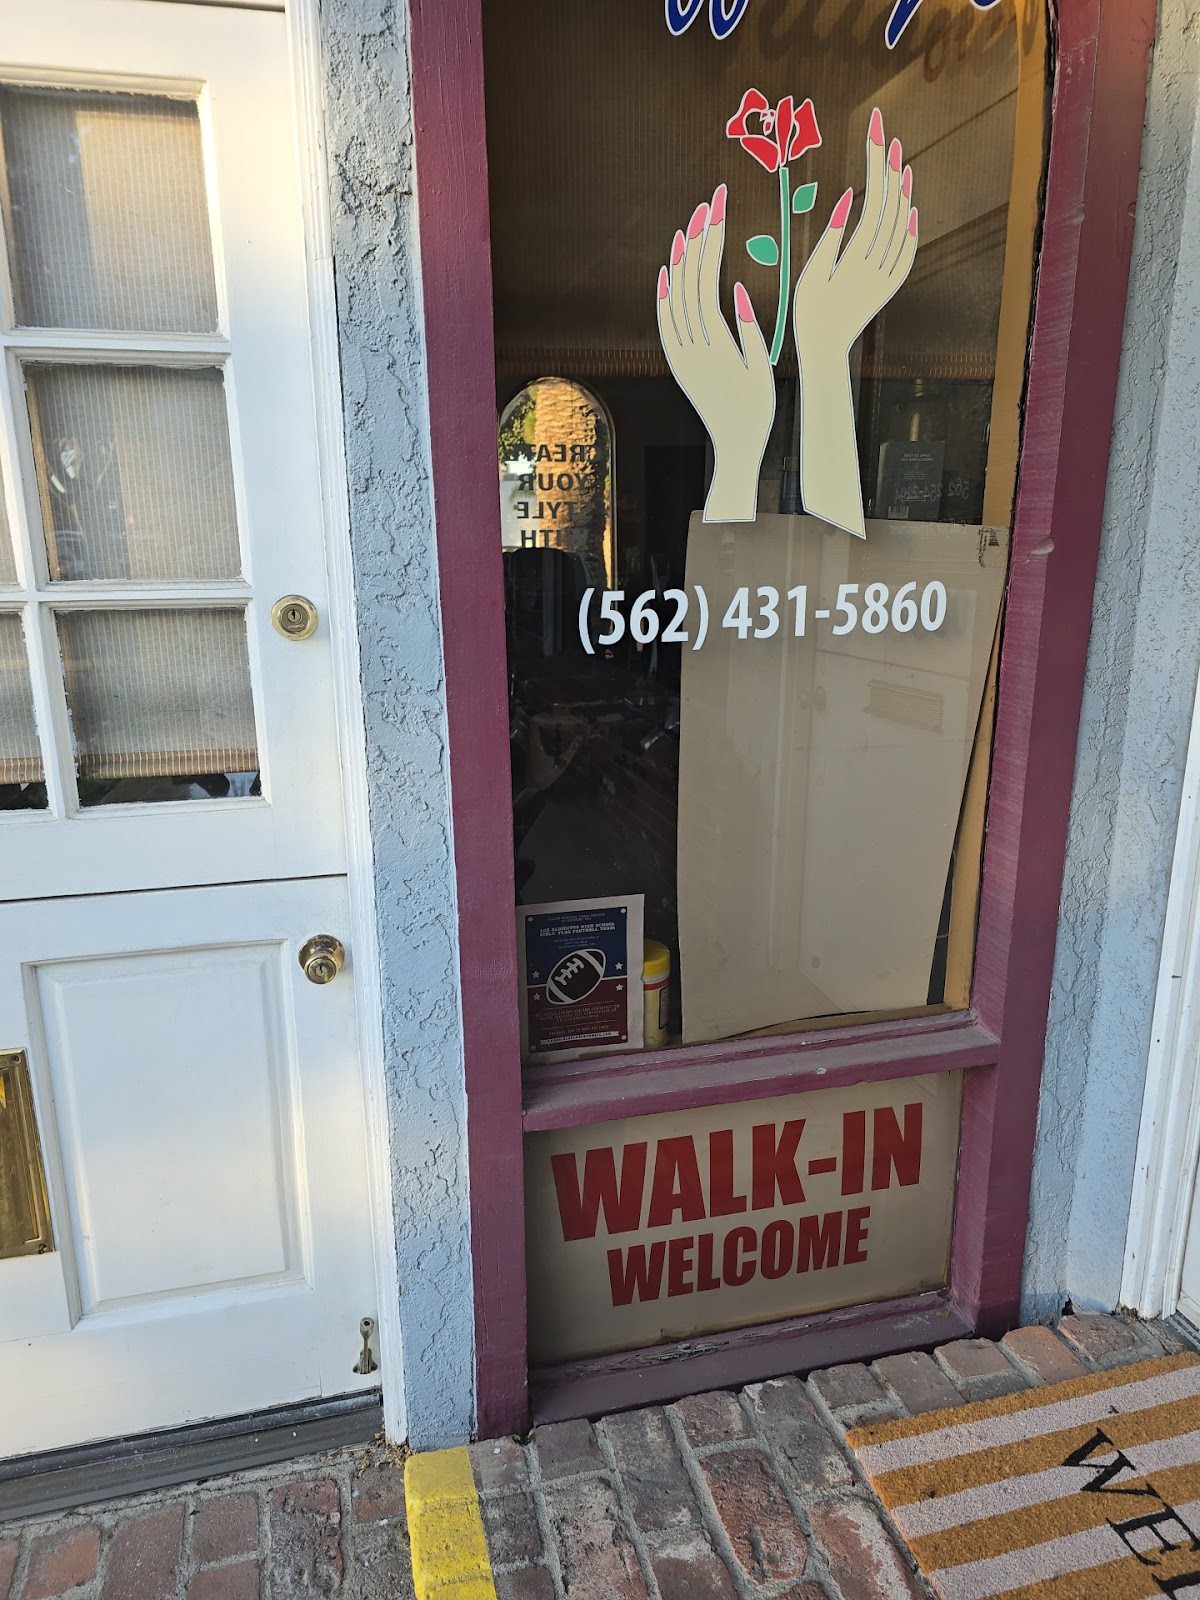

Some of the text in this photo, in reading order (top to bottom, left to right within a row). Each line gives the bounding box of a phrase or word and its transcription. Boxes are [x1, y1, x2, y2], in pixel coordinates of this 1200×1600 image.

[578, 580, 947, 654] (562) 431-5860
[551, 1102, 923, 1242] WALK-IN
[607, 1205, 871, 1307] WELCOME
